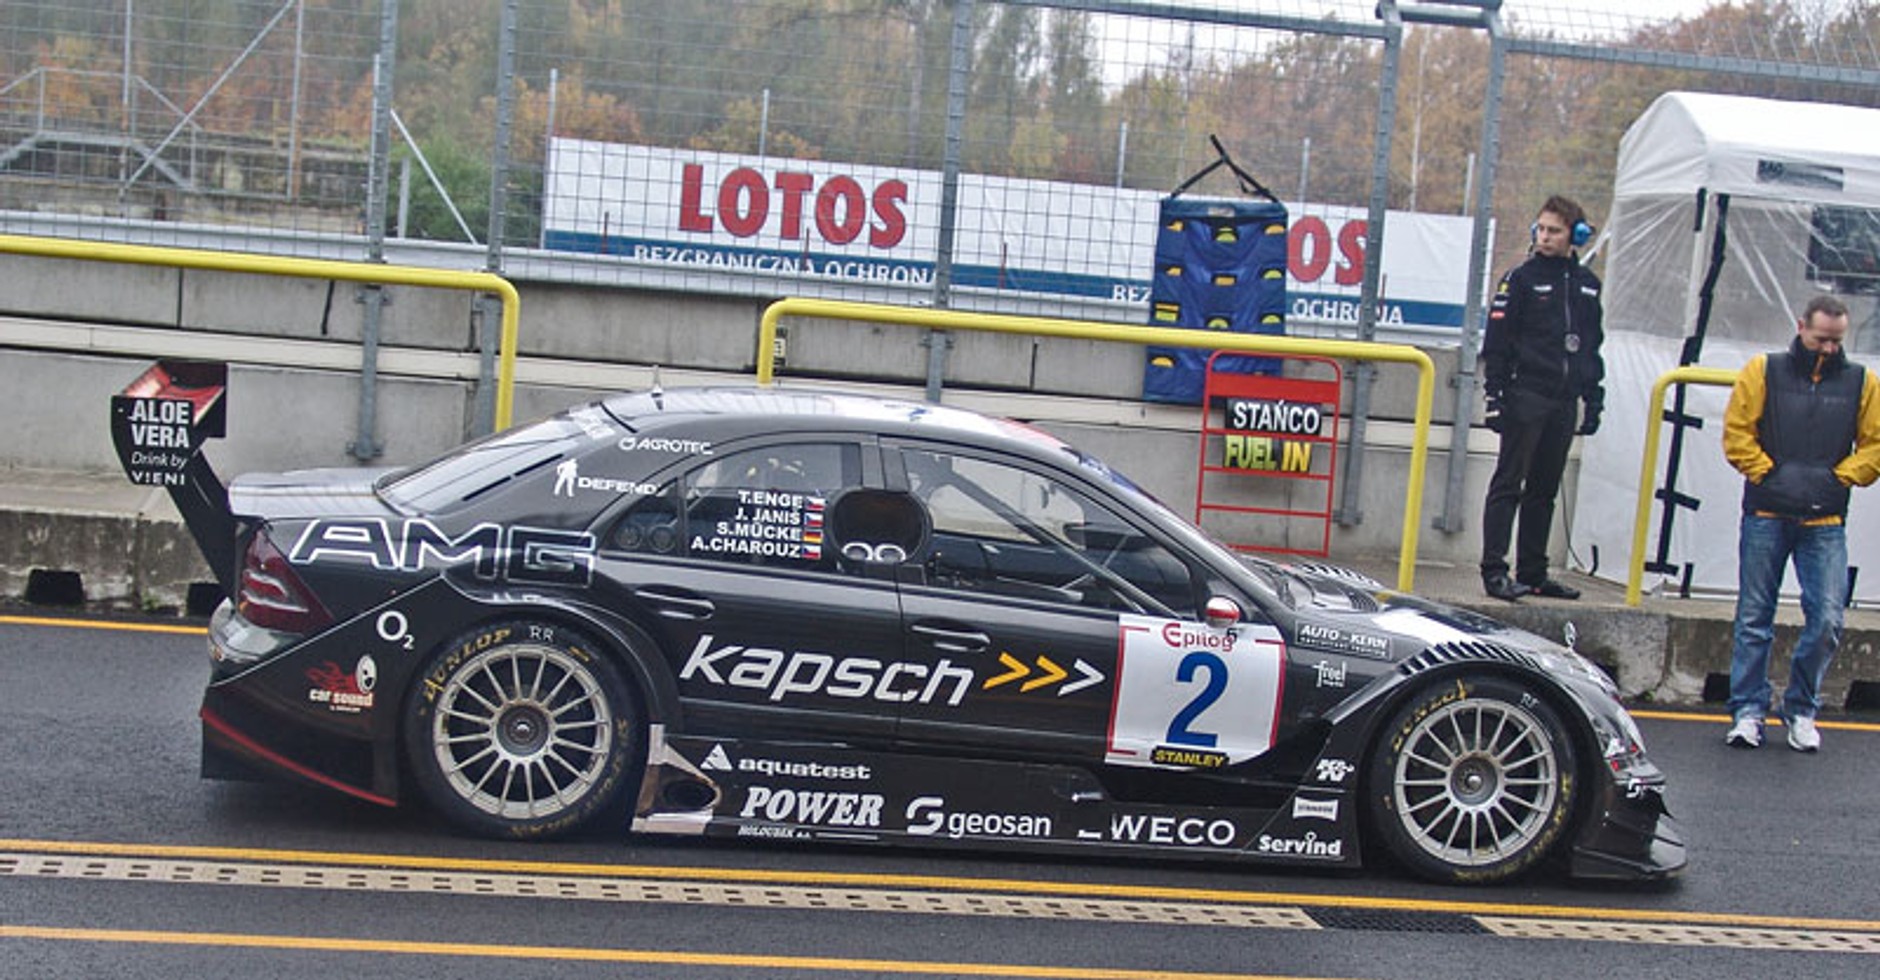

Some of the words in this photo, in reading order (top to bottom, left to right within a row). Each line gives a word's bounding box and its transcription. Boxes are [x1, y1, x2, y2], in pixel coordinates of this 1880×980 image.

[678, 163, 908, 249] LOTOS
[132, 400, 190, 425] ALOE
[1233, 399, 1319, 434] STAŃCO
[131, 423, 190, 448] VERA
[131, 451, 168, 467] Drink
[170, 454, 188, 471] by
[1224, 434, 1276, 471] FUEL
[1281, 441, 1312, 473] IN
[738, 490, 803, 508] T.ENGE
[717, 522, 802, 541] S.MÜCKE
[289, 517, 596, 588] AMG
[691, 536, 801, 558] A.CHAROUZ
[529, 625, 555, 642] RR
[679, 634, 976, 706] kapsch
[1165, 651, 1229, 748] 2
[738, 758, 872, 780] aquatest
[1153, 749, 1225, 767] STANLEY
[740, 786, 885, 827] POWER
[948, 812, 1052, 838] geosan
[1259, 832, 1342, 856] Servind
